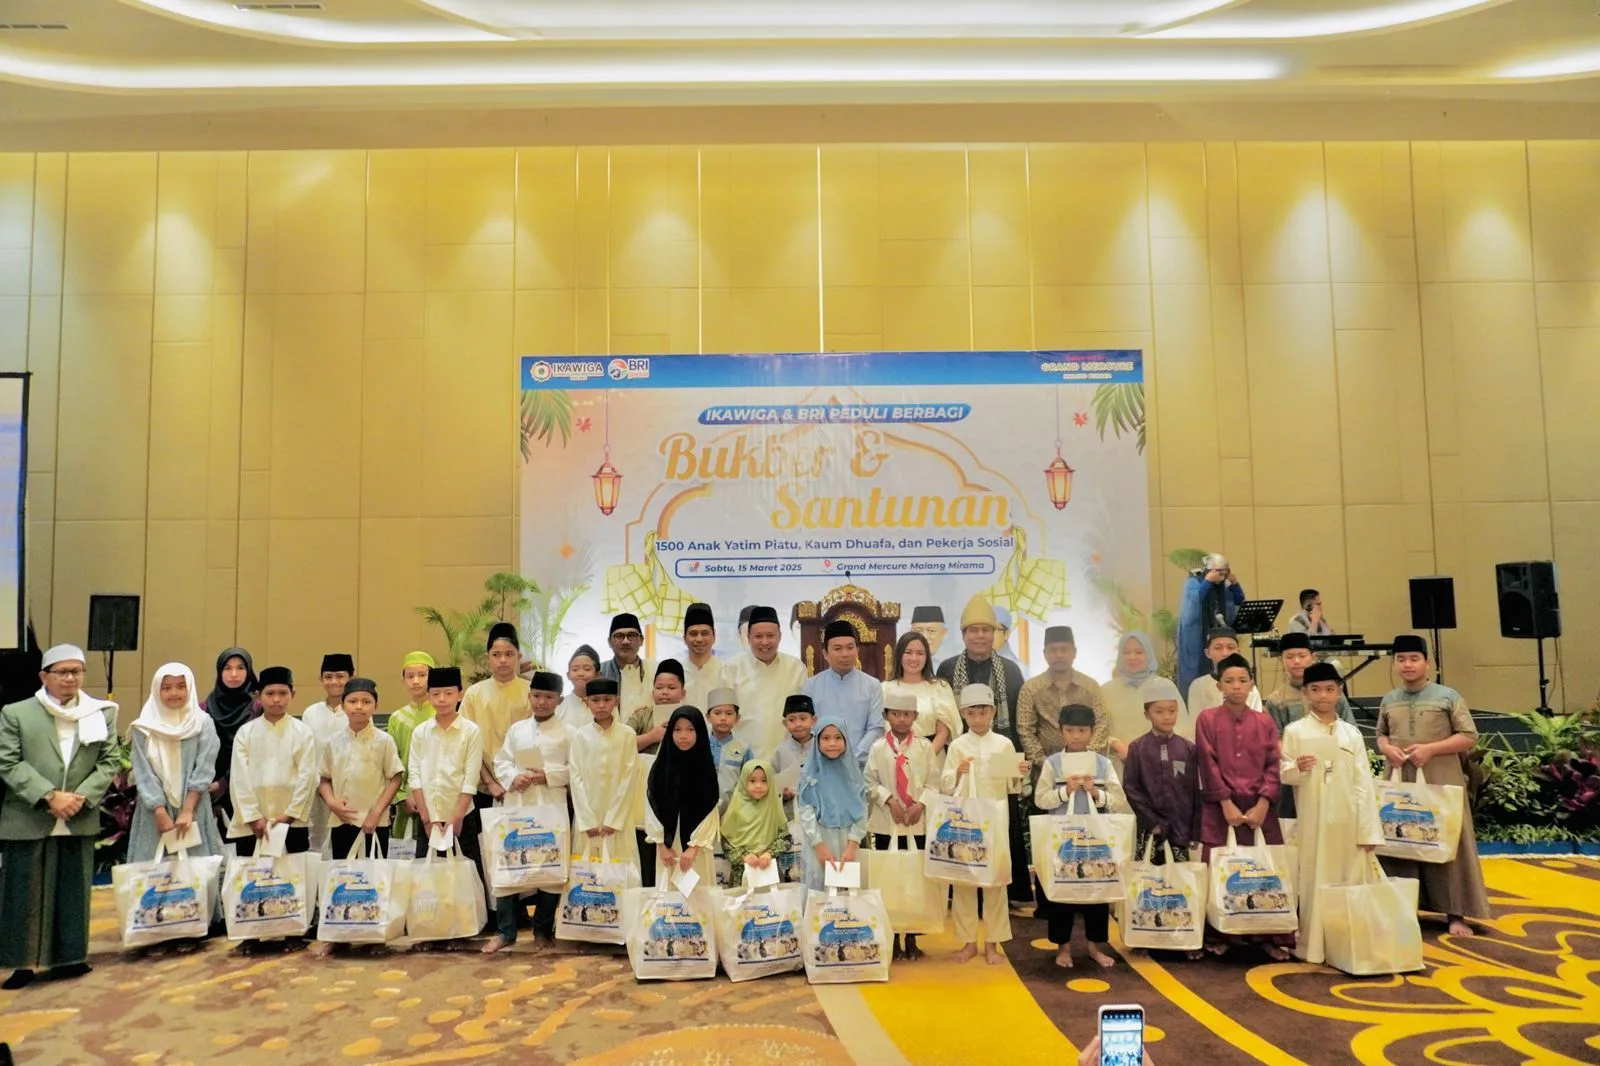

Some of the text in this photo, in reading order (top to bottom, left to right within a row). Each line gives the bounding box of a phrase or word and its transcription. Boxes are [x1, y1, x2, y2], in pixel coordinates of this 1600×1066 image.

[553, 363, 603, 372] IKAWIGA
[629, 360, 649, 370] BRI
[706, 406, 964, 421] IKAWIGA & BRI PEDULI BERBAGI
[851, 430, 890, 478] &
[770, 482, 1010, 530] Santunan
[656, 537, 1013, 551] 1500 Anak Yatim Piatu, Kaum Dhuafa, dan Pekerja Sosial
[705, 564, 802, 573] Sabtu, 15 Maret 2025
[837, 561, 985, 571] Grand Mercure Malang Mirama
